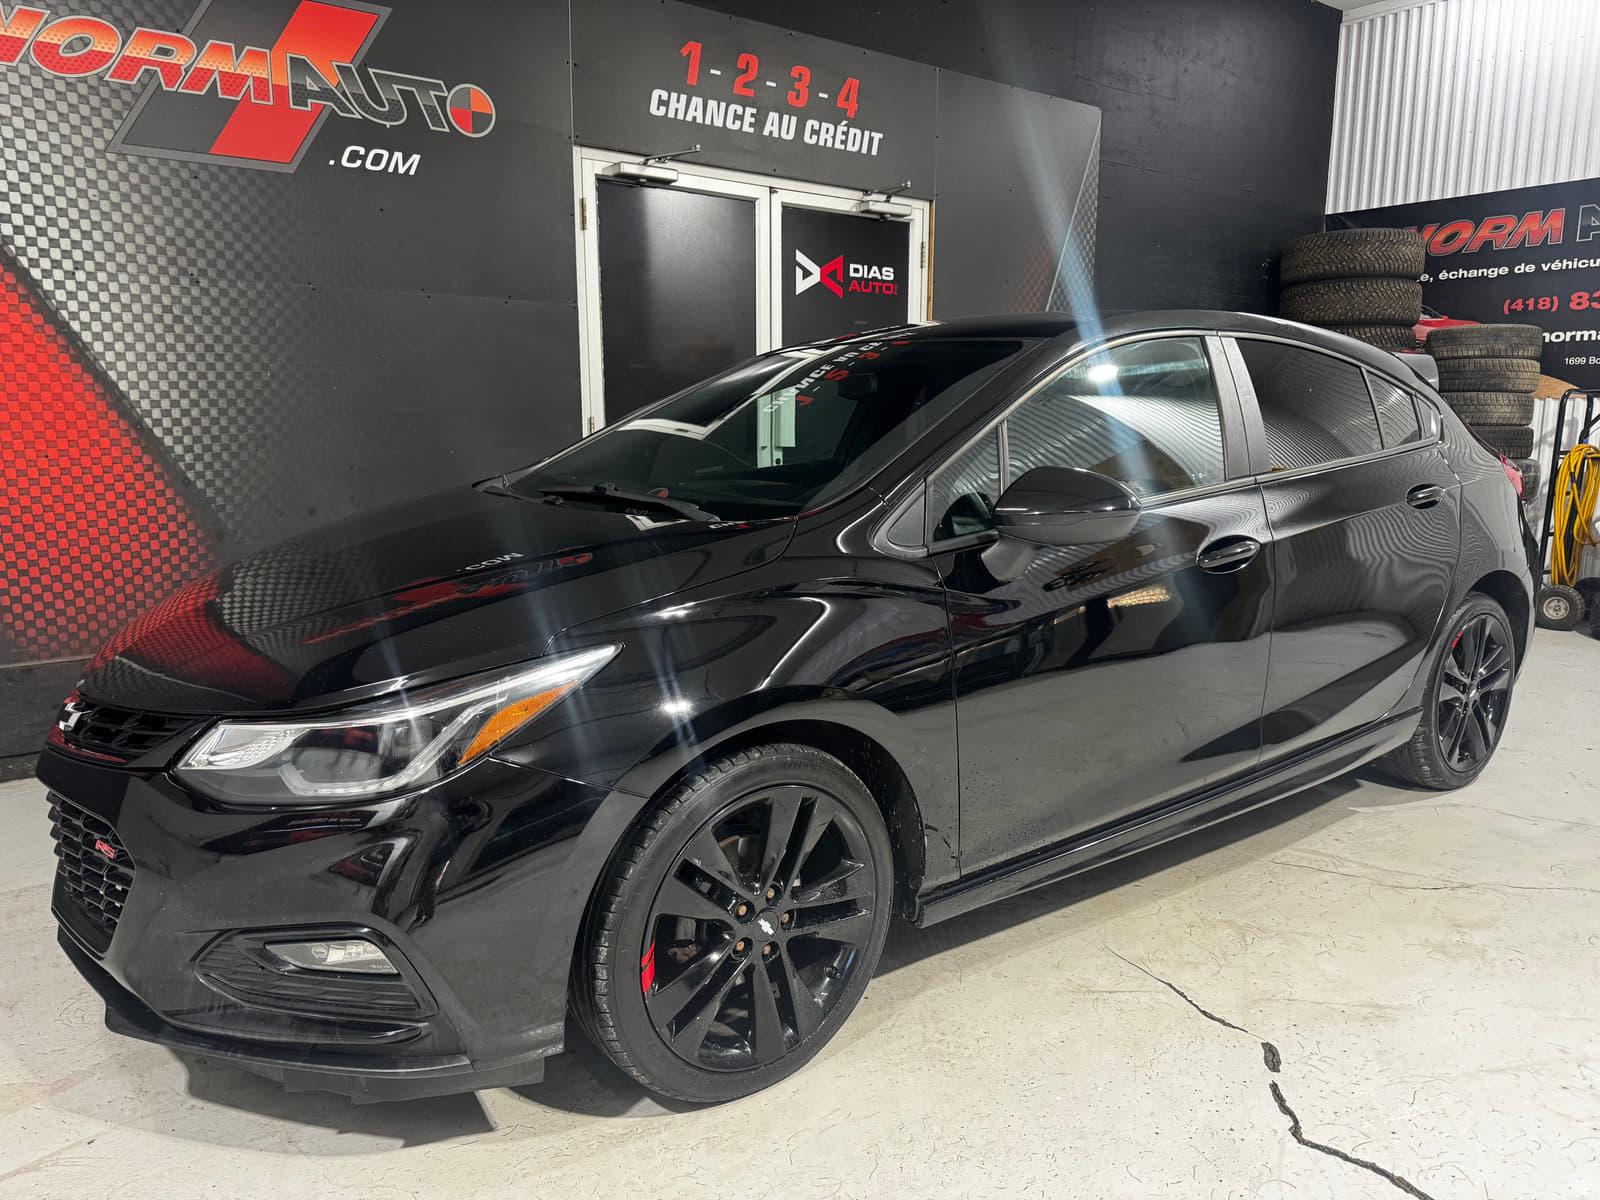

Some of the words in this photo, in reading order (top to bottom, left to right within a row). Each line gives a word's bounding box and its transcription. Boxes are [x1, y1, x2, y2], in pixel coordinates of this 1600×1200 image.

[649, 88, 757, 133] CHANCE
[762, 111, 798, 140] AU
[803, 120, 884, 156] CRÉDIT
[328, 145, 421, 176] .COM
[849, 263, 895, 281] DIAS
[1438, 265, 1509, 281] échange
[1514, 262, 1536, 273] de
[848, 279, 895, 295] AUTO
[1503, 295, 1559, 315] (418)
[1564, 357, 1586, 366] 1699
